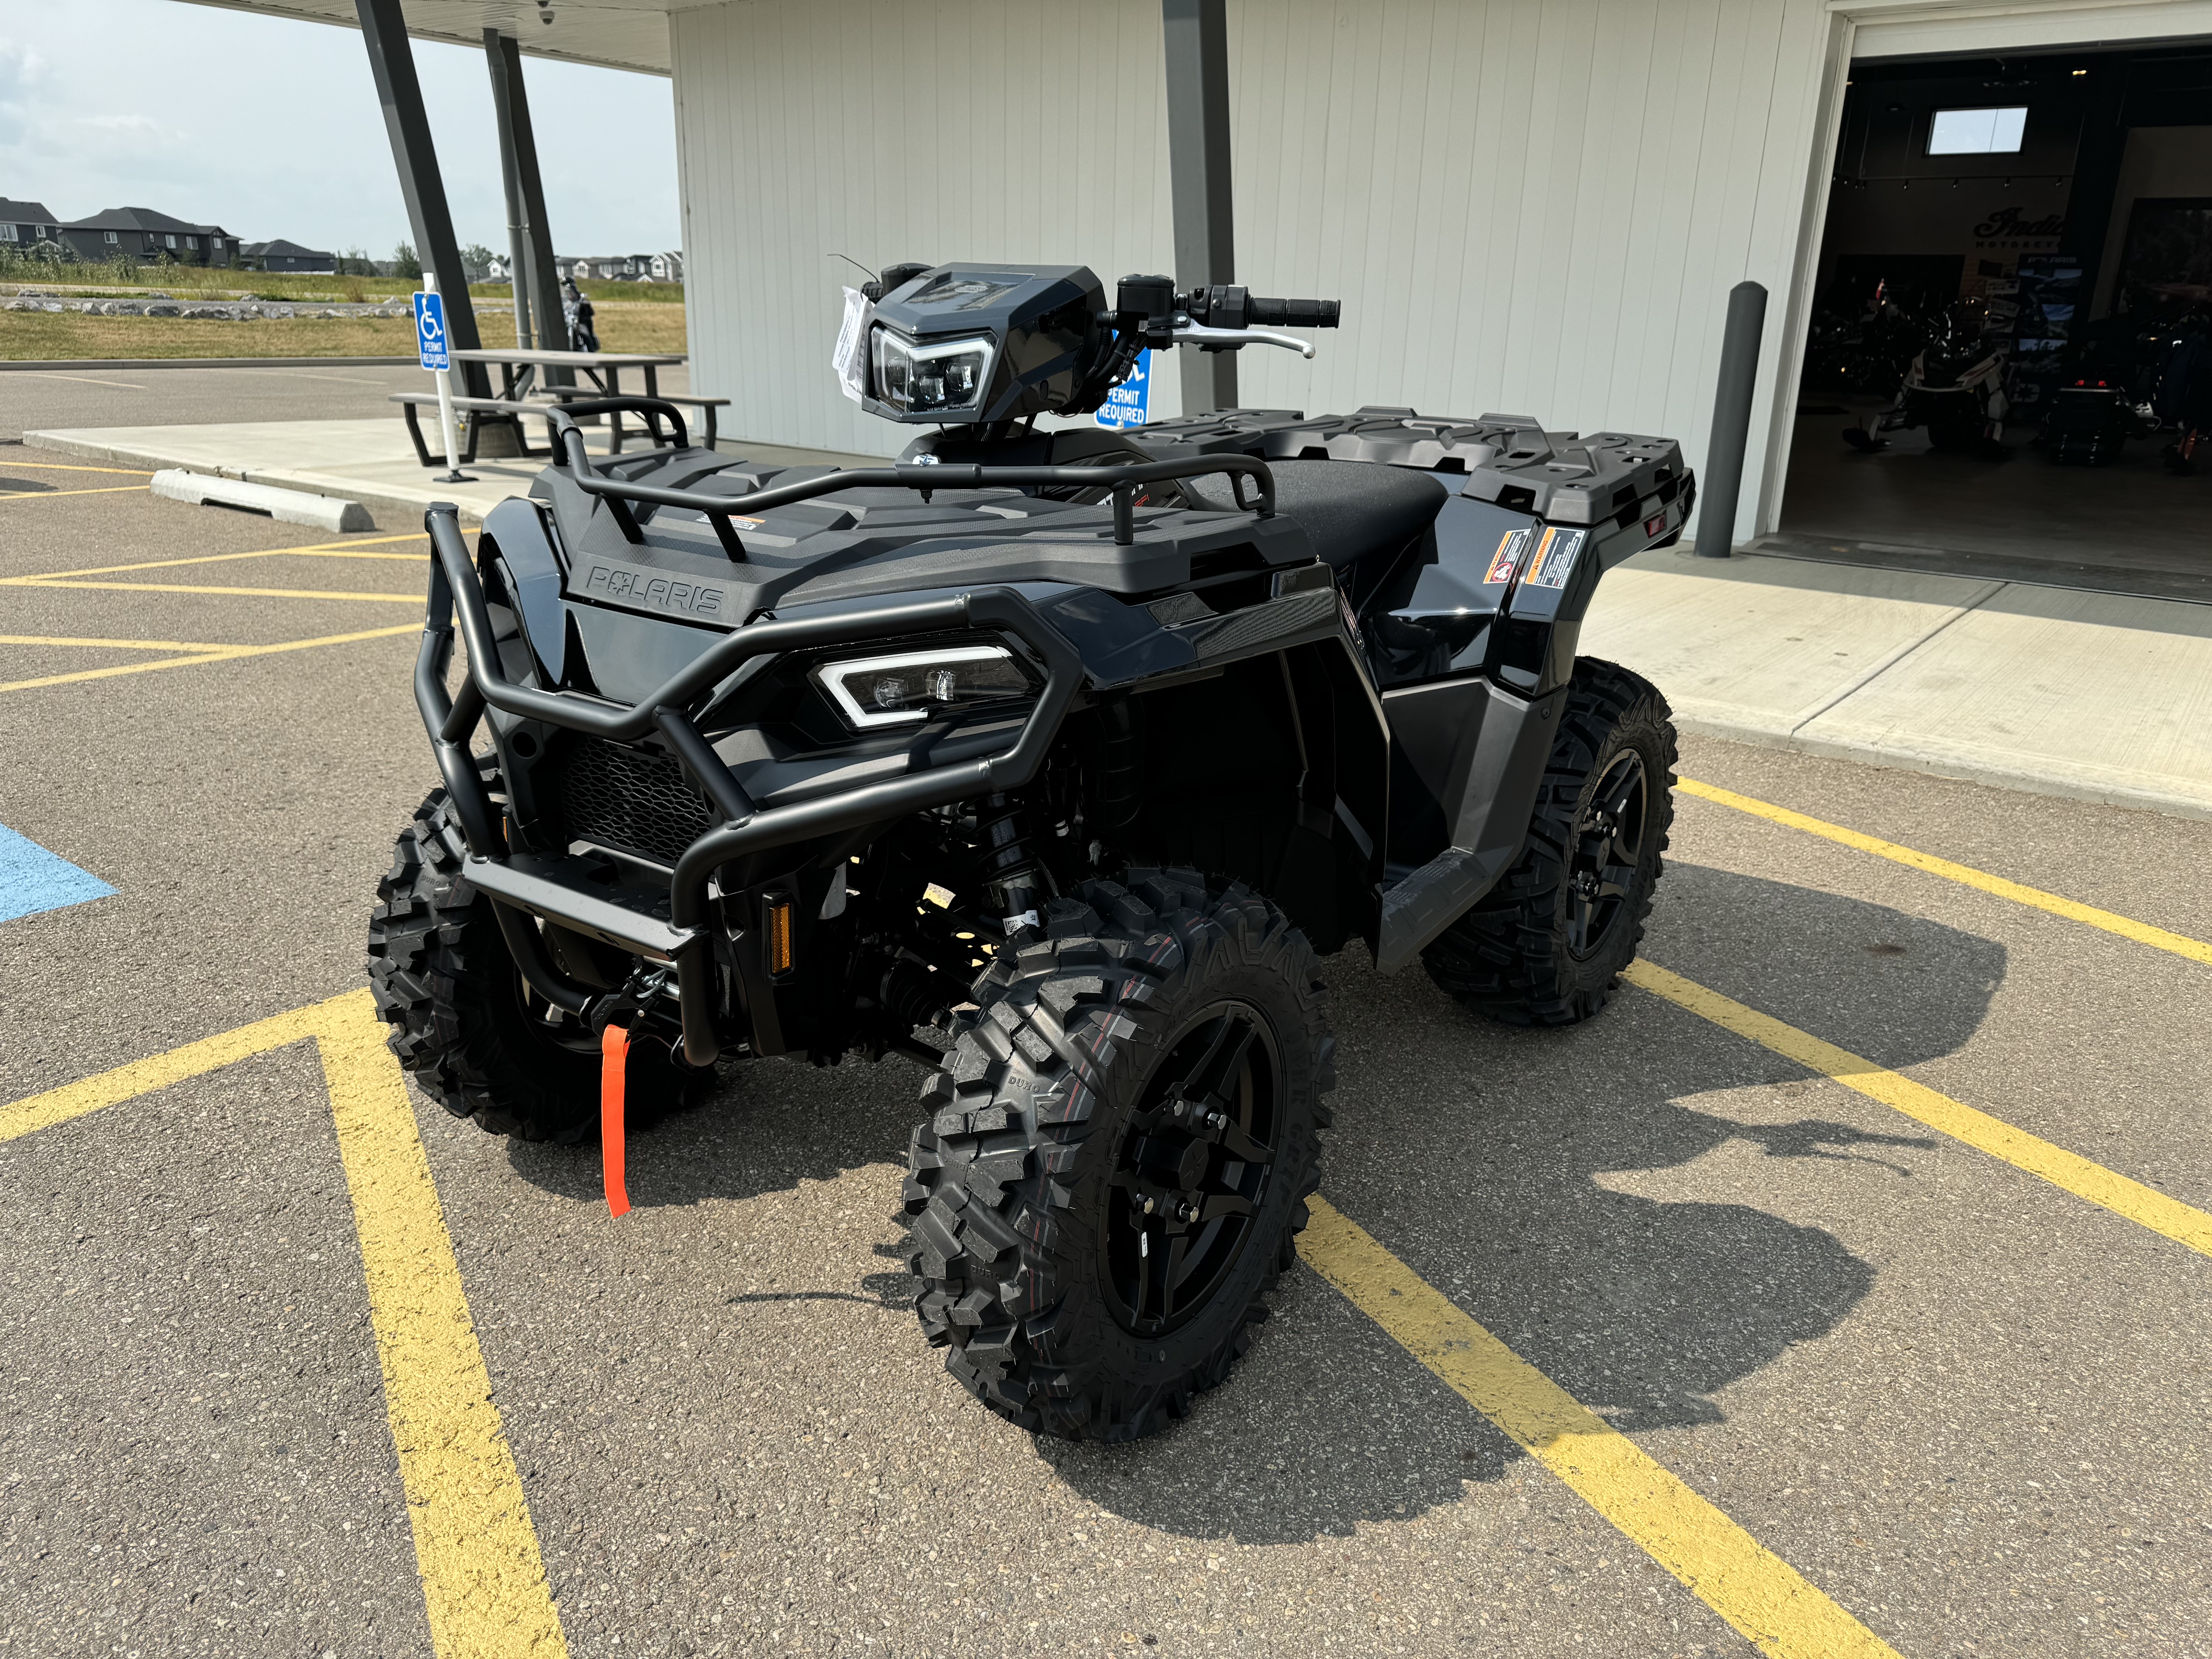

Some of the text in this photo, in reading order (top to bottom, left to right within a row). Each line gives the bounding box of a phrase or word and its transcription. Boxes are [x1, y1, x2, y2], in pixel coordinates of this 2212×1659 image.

[424, 341, 442, 353] PERMIT
[422, 353, 447, 365] REQUIRED
[1108, 388, 1139, 404] PERMIT
[1099, 404, 1144, 424] REQUIRED
[1535, 541, 1549, 565] WARNING
[586, 566, 724, 615] POLARIS
[421, 875, 441, 886] DURO
[1008, 1075, 1040, 1093] DURO
[970, 1264, 1002, 1280] DURO
